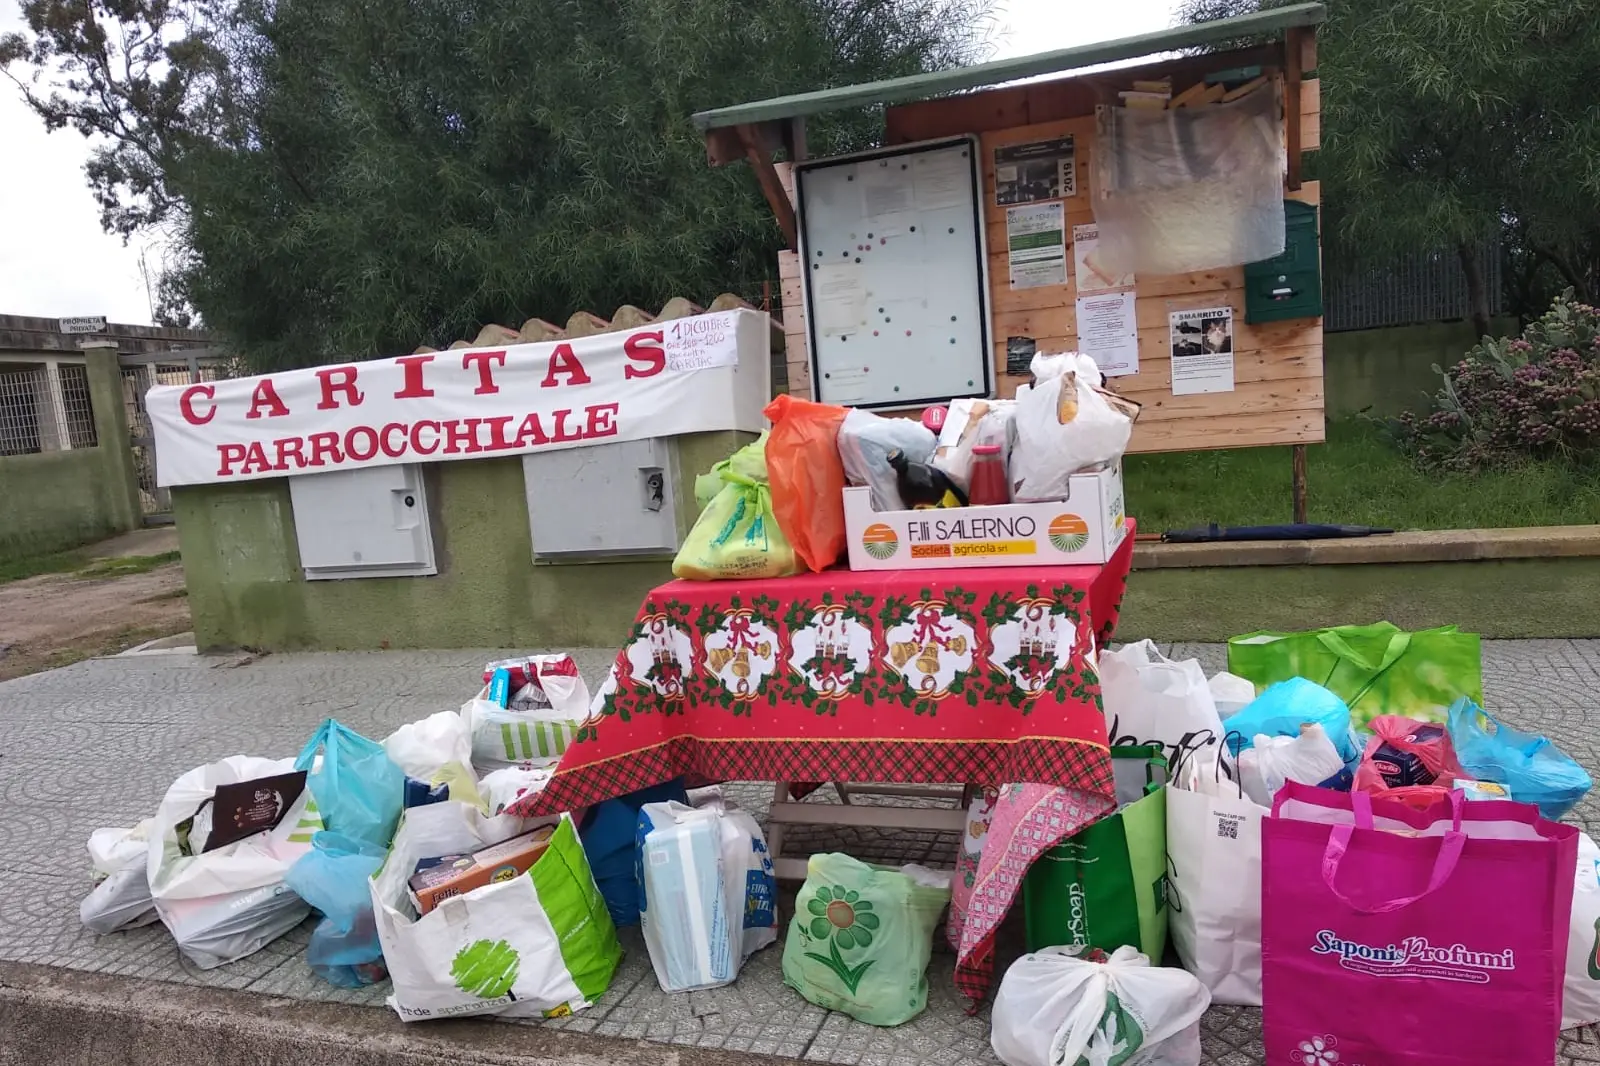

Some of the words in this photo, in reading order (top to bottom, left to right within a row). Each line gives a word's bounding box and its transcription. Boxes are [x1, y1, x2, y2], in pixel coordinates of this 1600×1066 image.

[1063, 163, 1073, 193] 2019
[1179, 310, 1224, 321] SMARRITO
[671, 322, 681, 340] 1
[179, 331, 667, 425] CARITAS
[217, 402, 620, 476] PARROCCHIALE
[936, 516, 1036, 540] SALERNO
[954, 543, 996, 557] agricola
[437, 998, 508, 1015] speranza
